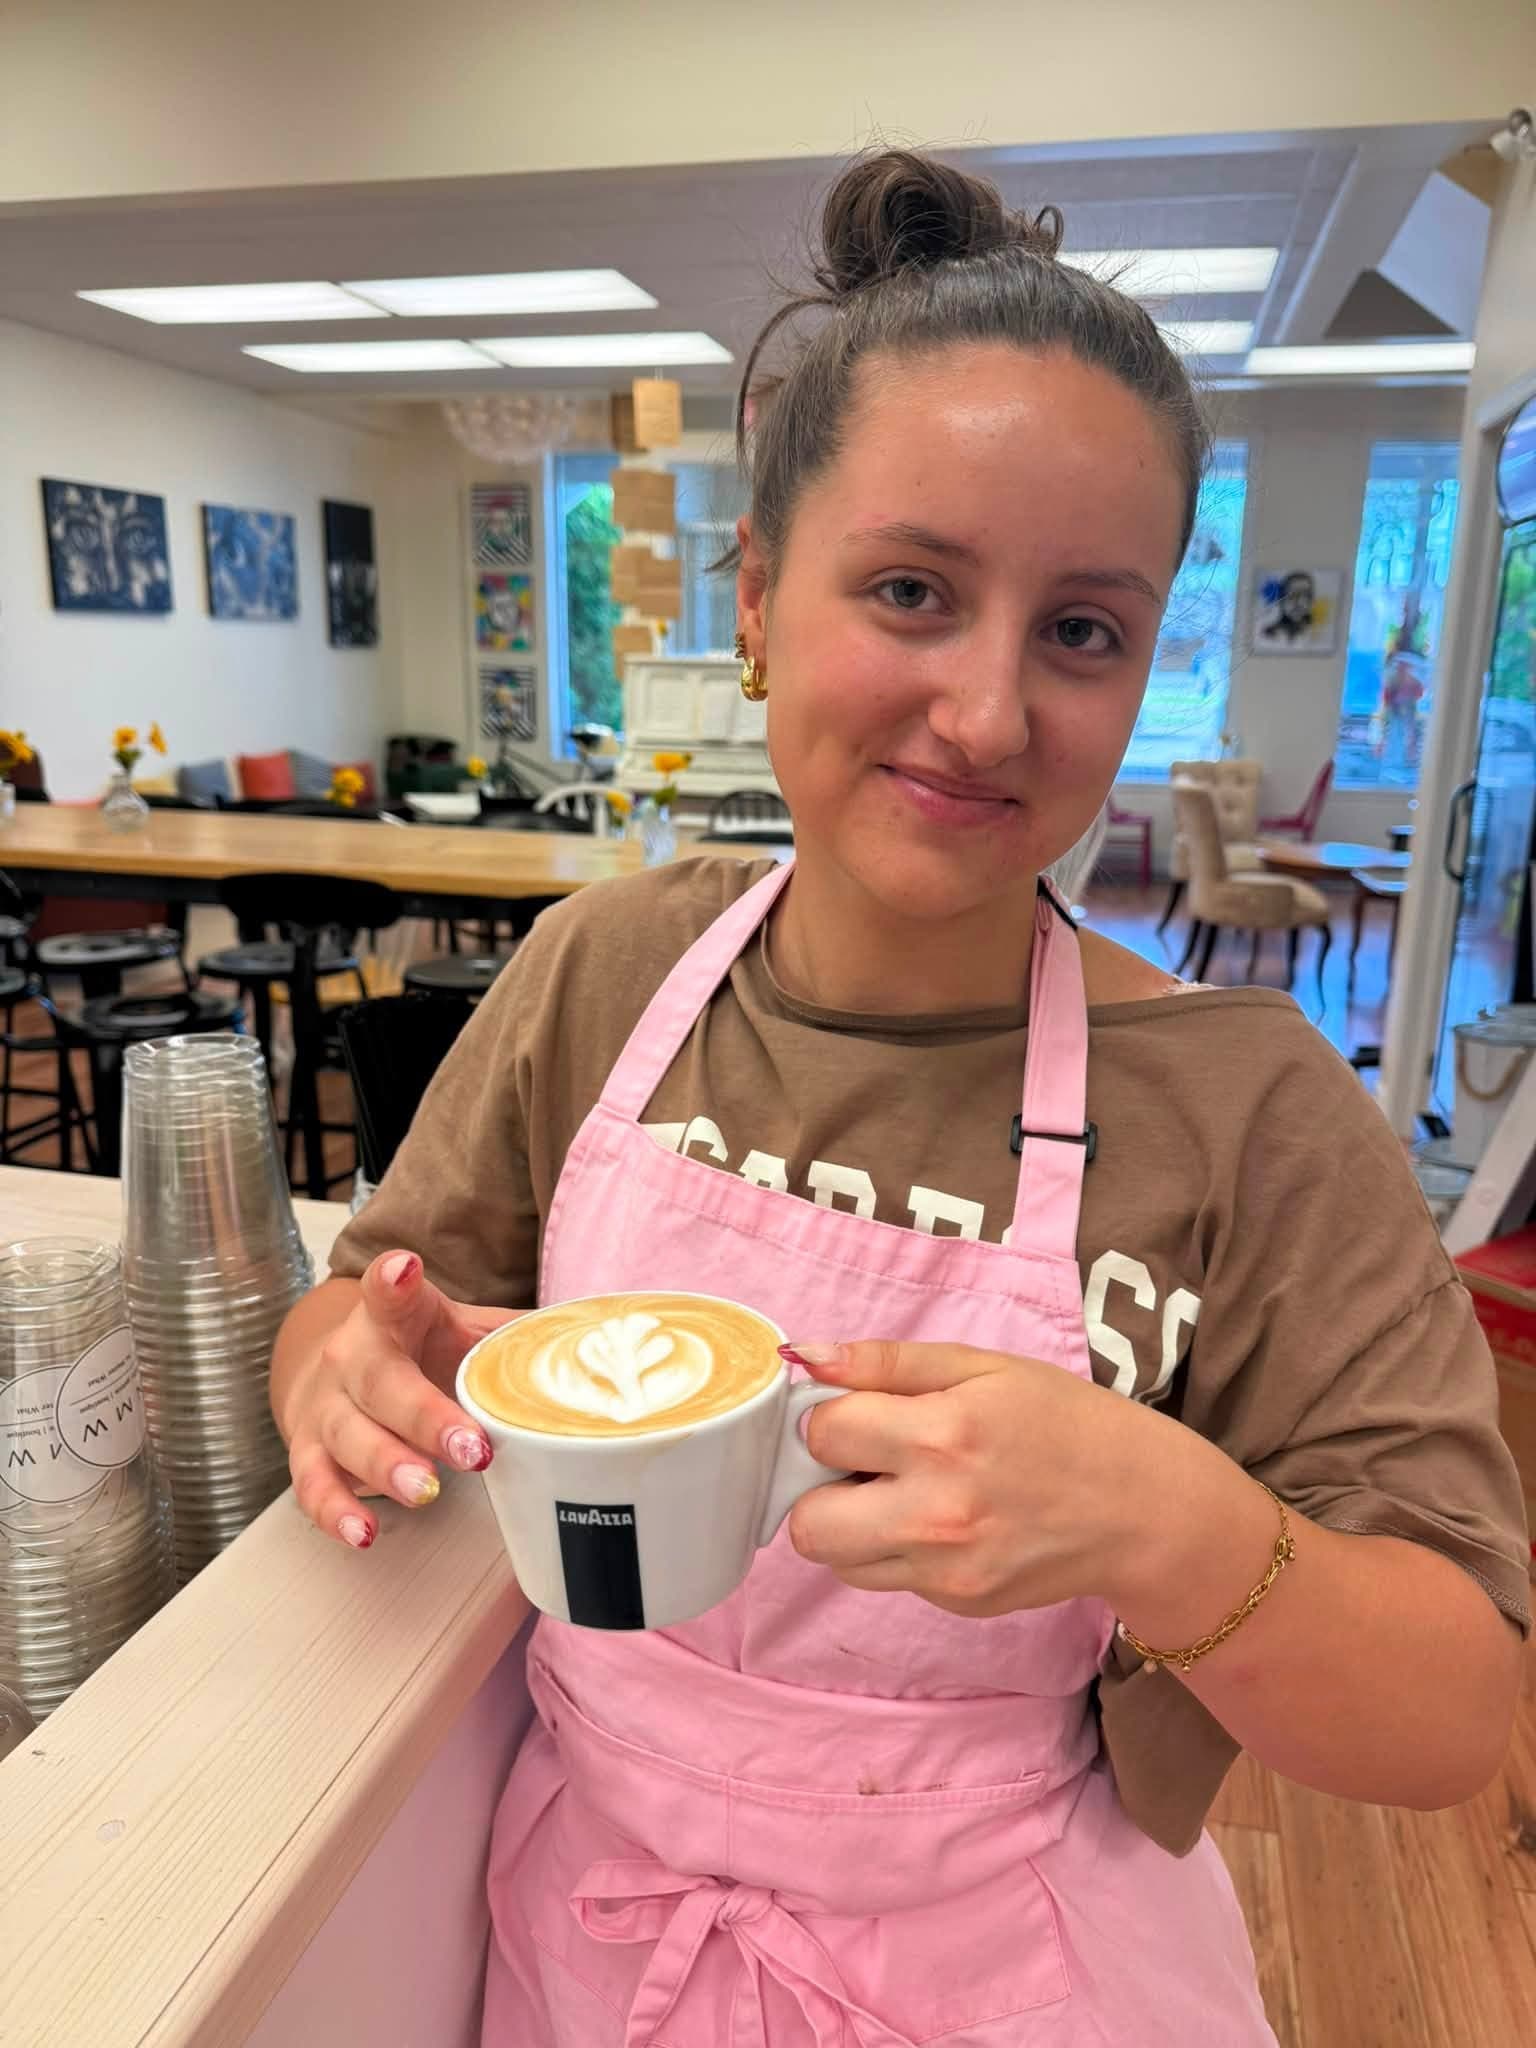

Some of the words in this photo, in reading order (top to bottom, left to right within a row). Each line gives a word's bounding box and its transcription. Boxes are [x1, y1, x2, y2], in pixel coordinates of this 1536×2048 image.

[17, 1407, 40, 1415] What
[83, 1418, 109, 1443] W
[8, 1448, 37, 1469] W
[559, 1508, 633, 1526] LAVAZZA
